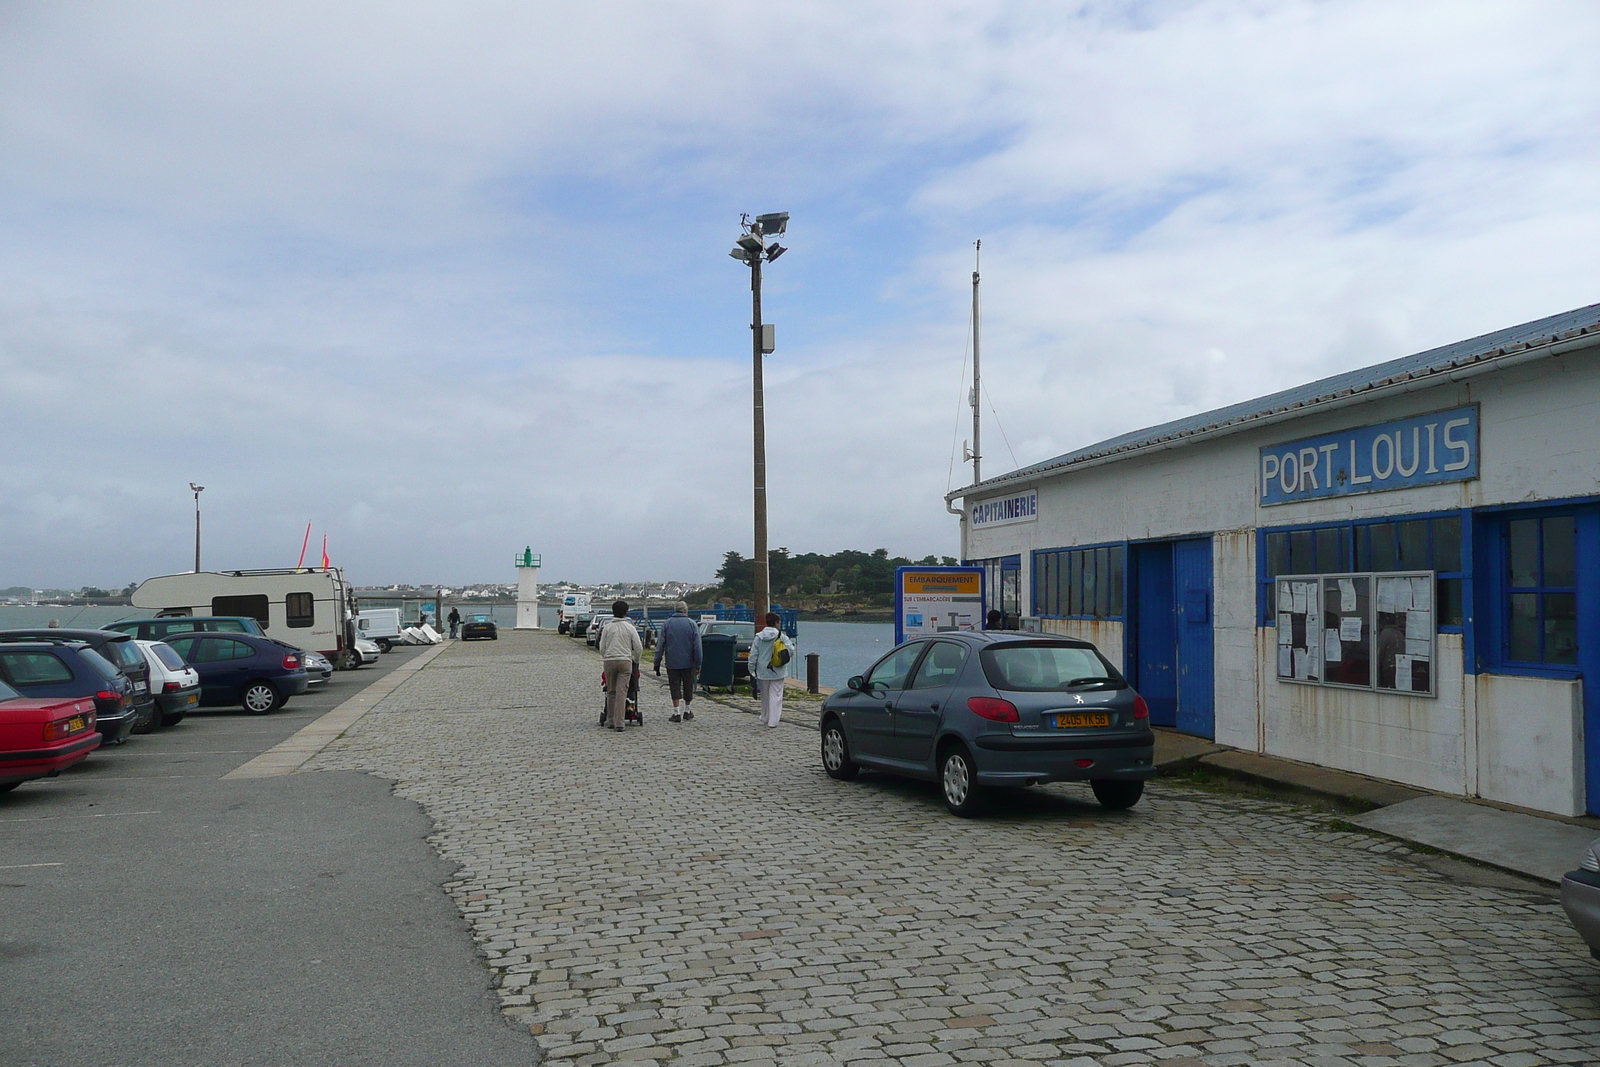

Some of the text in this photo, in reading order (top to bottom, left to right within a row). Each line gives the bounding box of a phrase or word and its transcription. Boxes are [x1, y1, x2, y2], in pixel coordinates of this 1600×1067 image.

[1262, 417, 1471, 497] PORT LOUIS
[972, 494, 1036, 525] CAPITAINERIE
[909, 576, 974, 584] EMBARQUEMENT
[1060, 713, 1106, 726] 2405 YK 56
